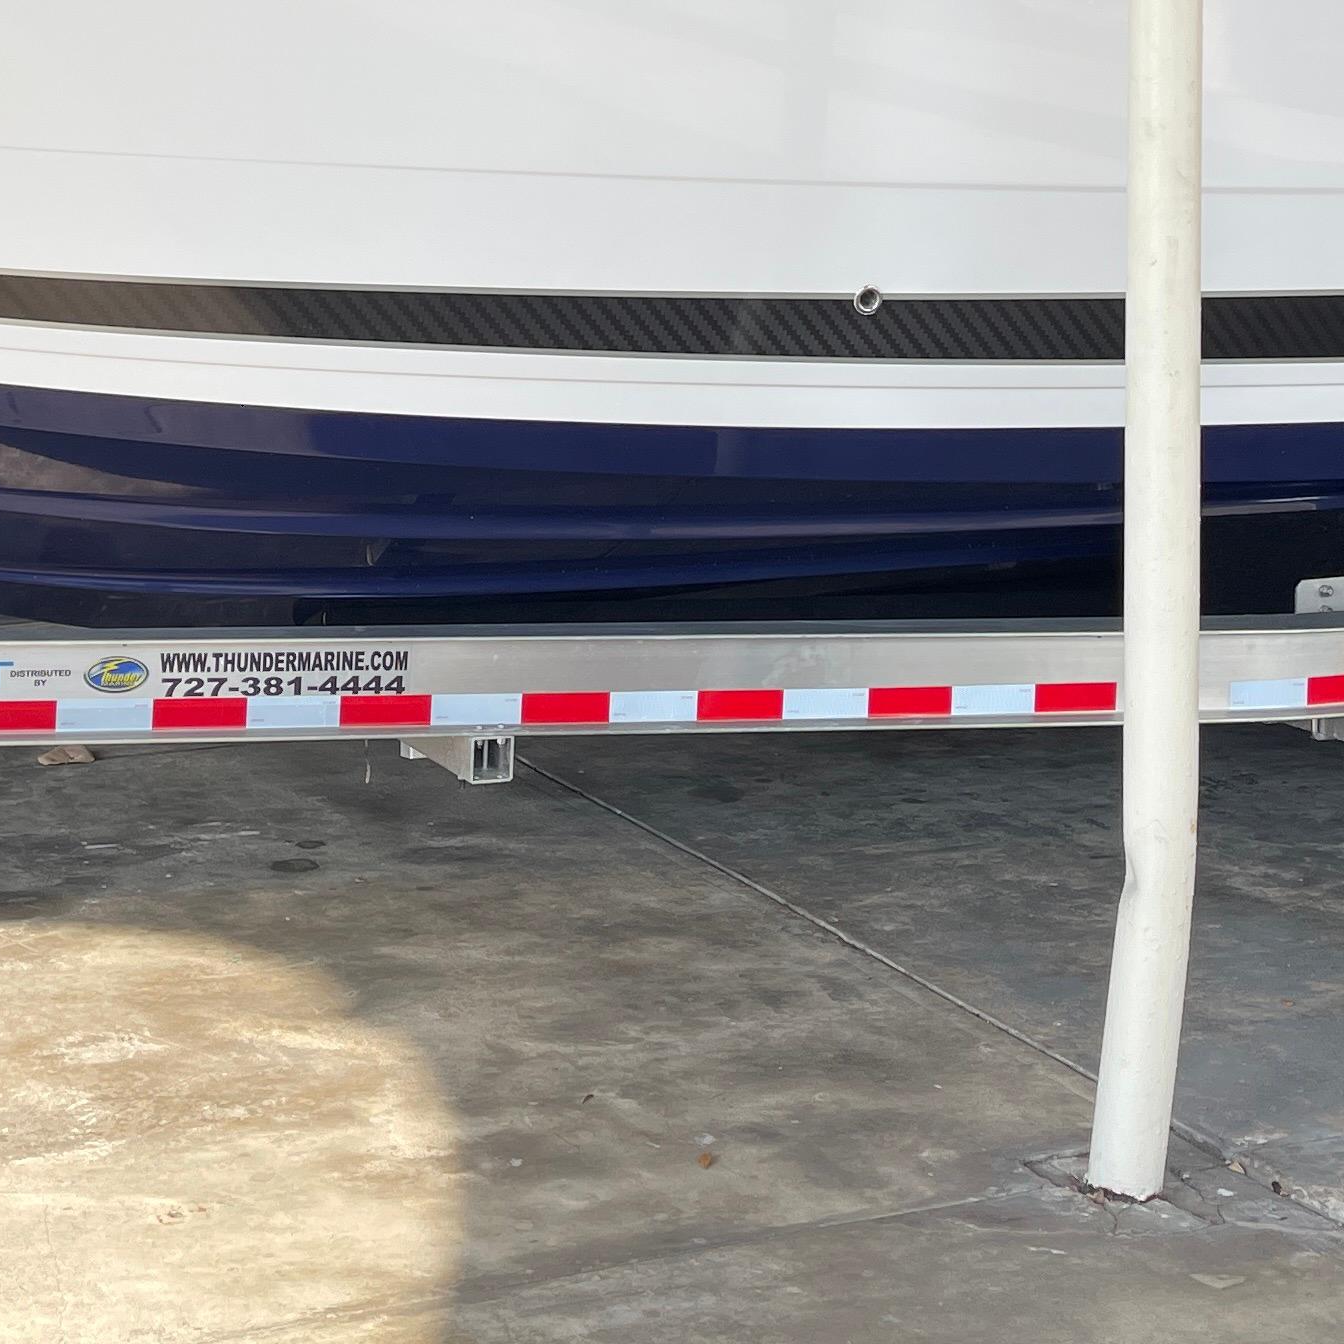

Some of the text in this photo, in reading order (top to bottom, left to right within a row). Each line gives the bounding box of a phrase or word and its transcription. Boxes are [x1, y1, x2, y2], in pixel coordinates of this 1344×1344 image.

[160, 651, 408, 673] WWW.THUNDERMARINE.COM
[10, 669, 71, 678] DISTRIBUTED
[34, 679, 47, 687] BY
[161, 675, 405, 697] 727-381-4444
